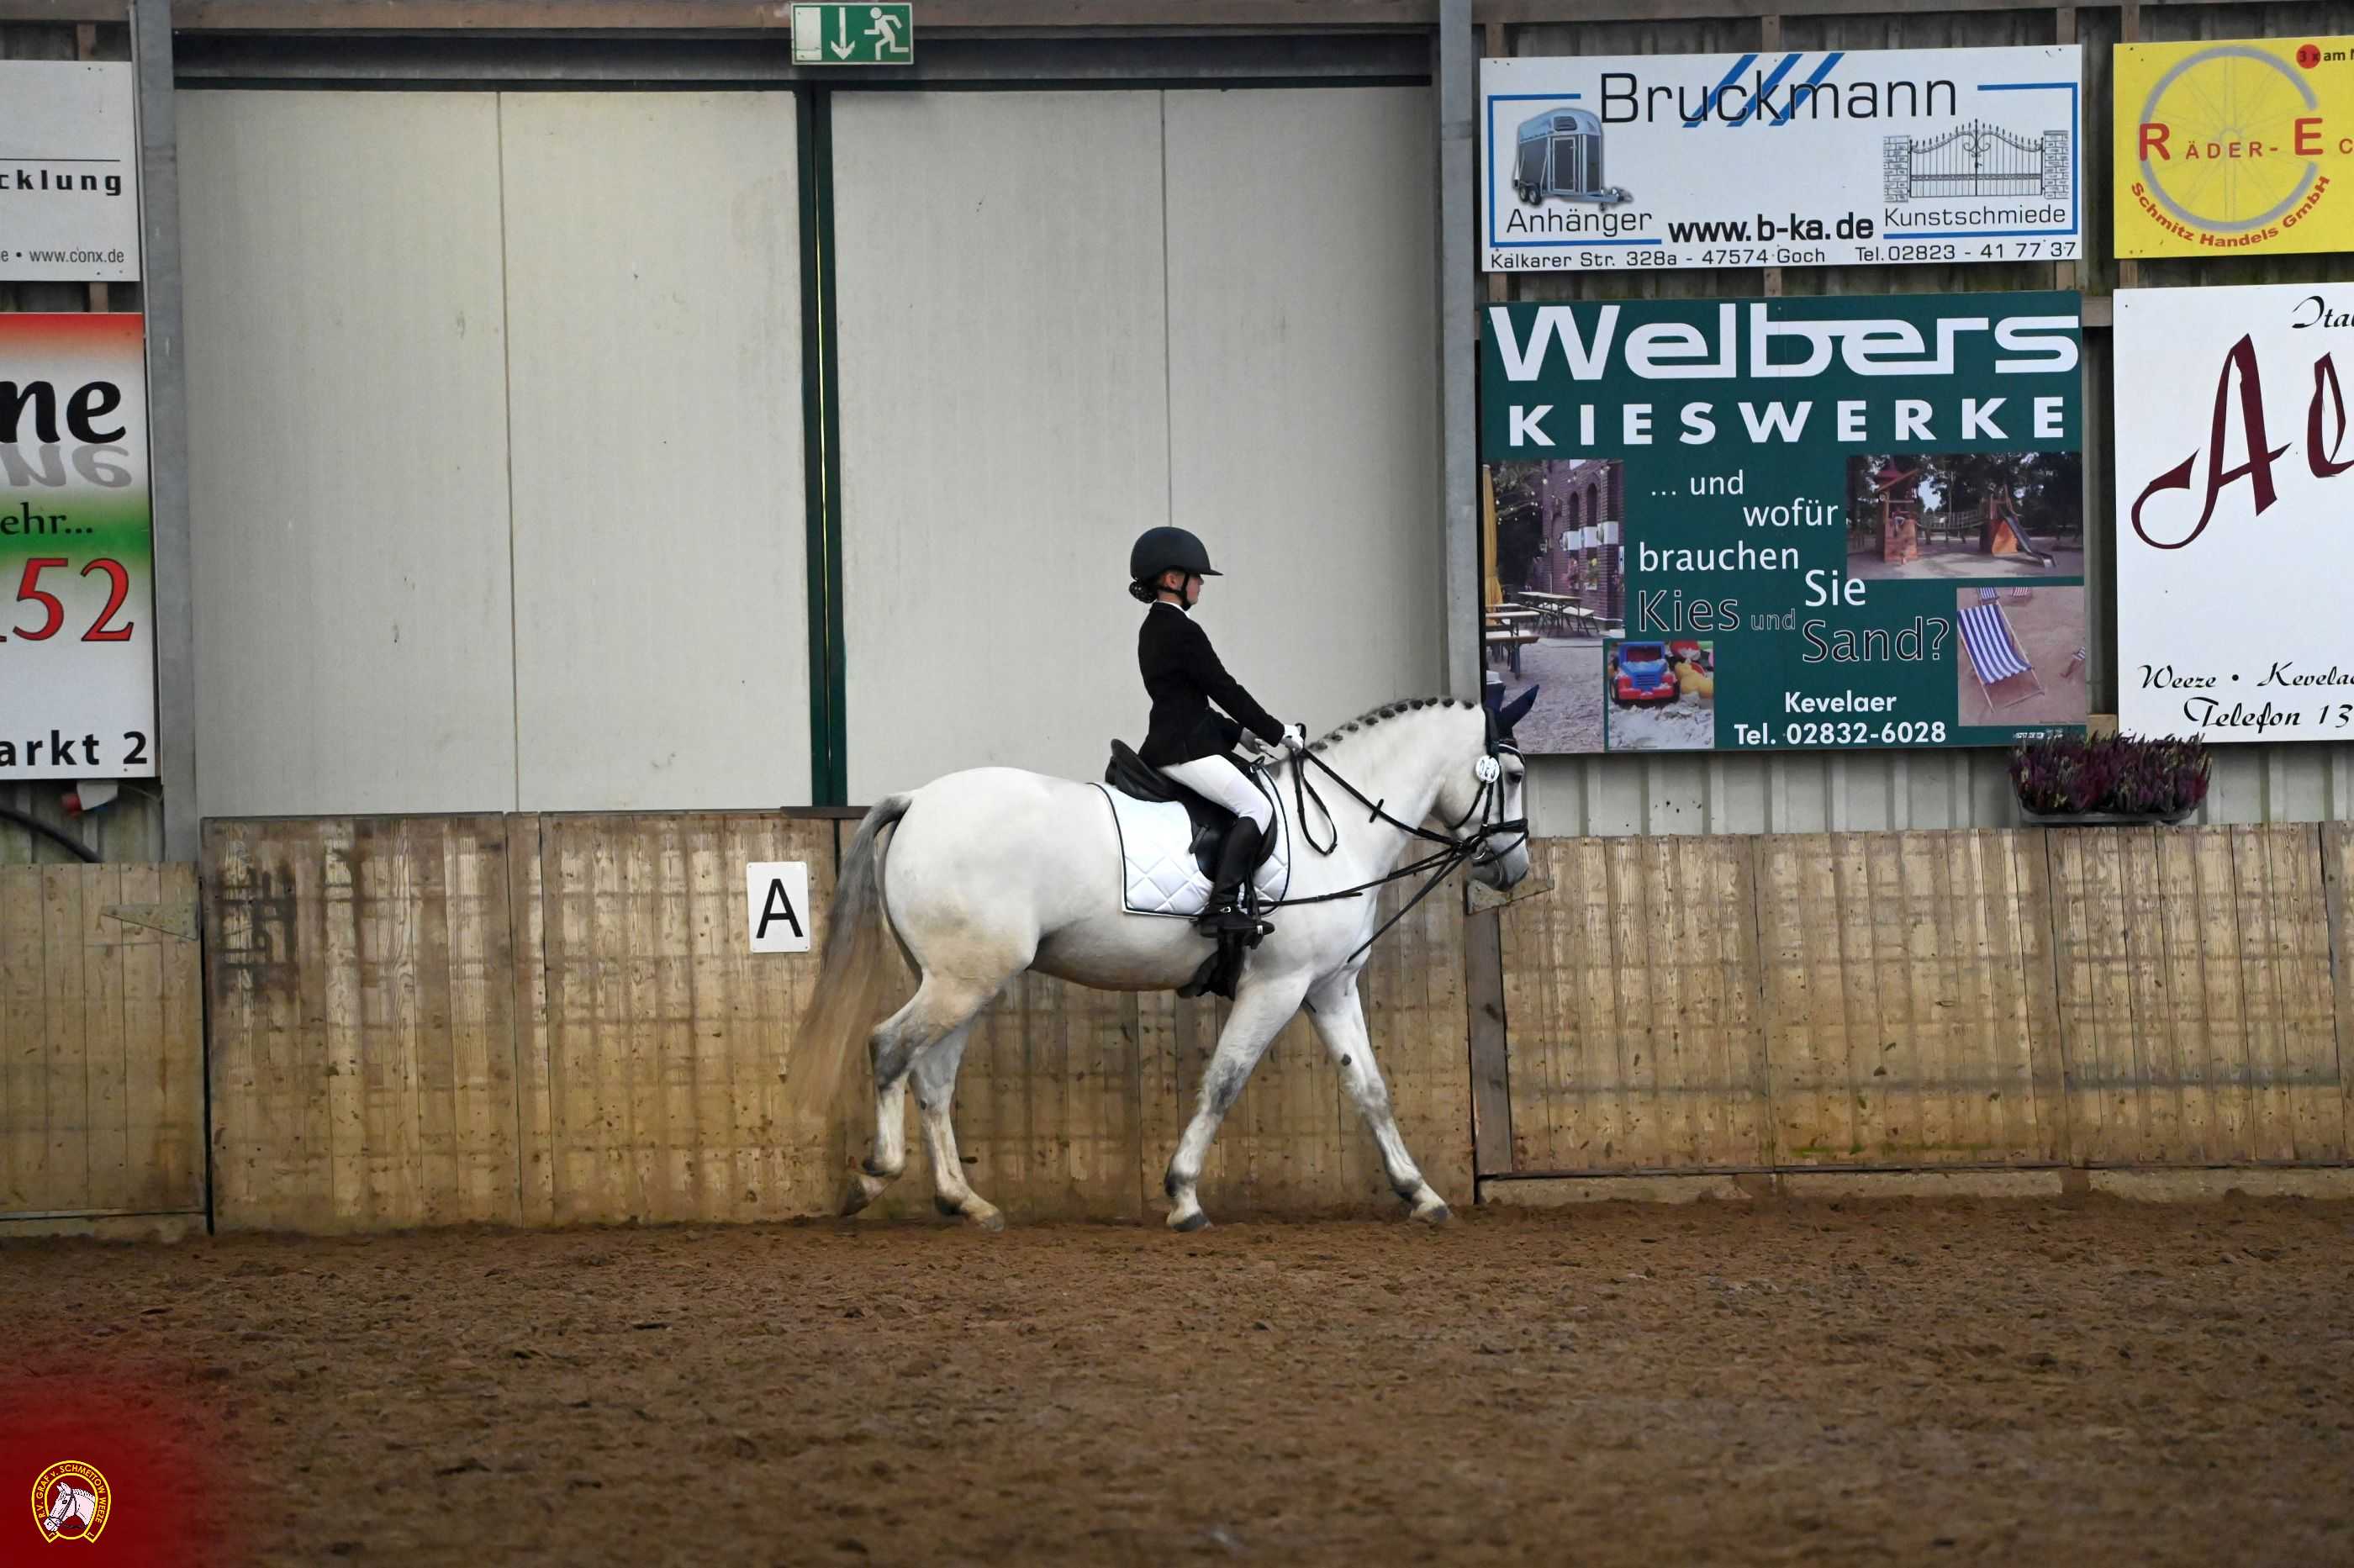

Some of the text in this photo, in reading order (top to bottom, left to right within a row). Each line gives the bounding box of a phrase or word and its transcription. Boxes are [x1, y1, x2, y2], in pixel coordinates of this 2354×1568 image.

[2323, 51, 2346, 61] am
[1601, 71, 1957, 124] Bruckmann
[1506, 208, 1653, 238] Anhänger
[1667, 211, 1875, 244] www.b-ka.de
[1884, 204, 2066, 227] Kunstschmiede
[2131, 176, 2330, 247] Schmitz Handels GmbH
[29, 248, 125, 263] www.conx.de
[1491, 253, 1572, 269] Kalkarer
[1581, 251, 1615, 267] Str.
[1627, 251, 1677, 267] 328a
[1702, 249, 1769, 266] 47574
[1776, 247, 1826, 264] Goch
[1980, 243, 2004, 259] 41
[2015, 242, 2041, 258] 77
[2050, 241, 2076, 257] 37
[1489, 302, 2079, 382] Welbers
[1508, 396, 2065, 447] KIESWERKE
[1690, 469, 1744, 496] und
[1743, 498, 1839, 526] wofür
[1639, 541, 1799, 572] brauchen
[0, 557, 135, 641] 52
[1805, 569, 1866, 607] Sie
[1639, 589, 1797, 632] Kies und
[1802, 615, 1950, 663] Sand?
[2138, 664, 2217, 689] Weeze
[1785, 689, 1897, 713] Kevelaer
[2183, 696, 2302, 734] Telefon
[123, 731, 147, 764] 2
[1734, 721, 1946, 745] Tel. 02832-6028
[755, 878, 804, 939] A
